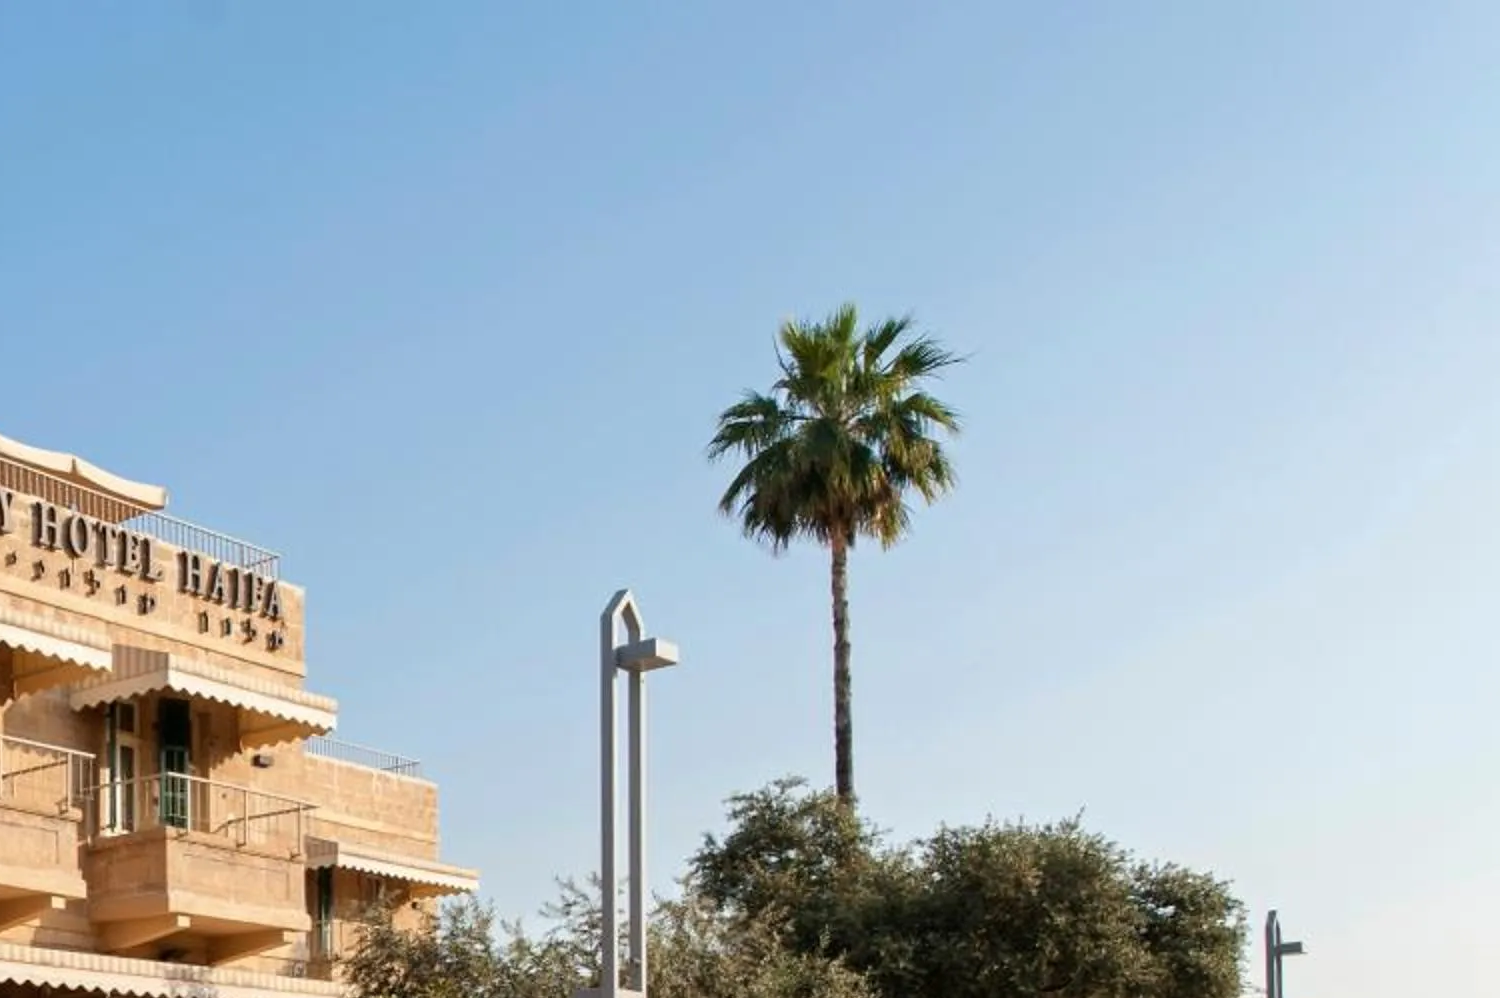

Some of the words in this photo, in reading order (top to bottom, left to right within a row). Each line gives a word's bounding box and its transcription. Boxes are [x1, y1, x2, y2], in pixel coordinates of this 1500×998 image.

[4, 550, 156, 616] קולוני
[30, 501, 166, 585] HOTEL
[177, 551, 284, 622] HAIFA
[197, 610, 284, 653] מלון
